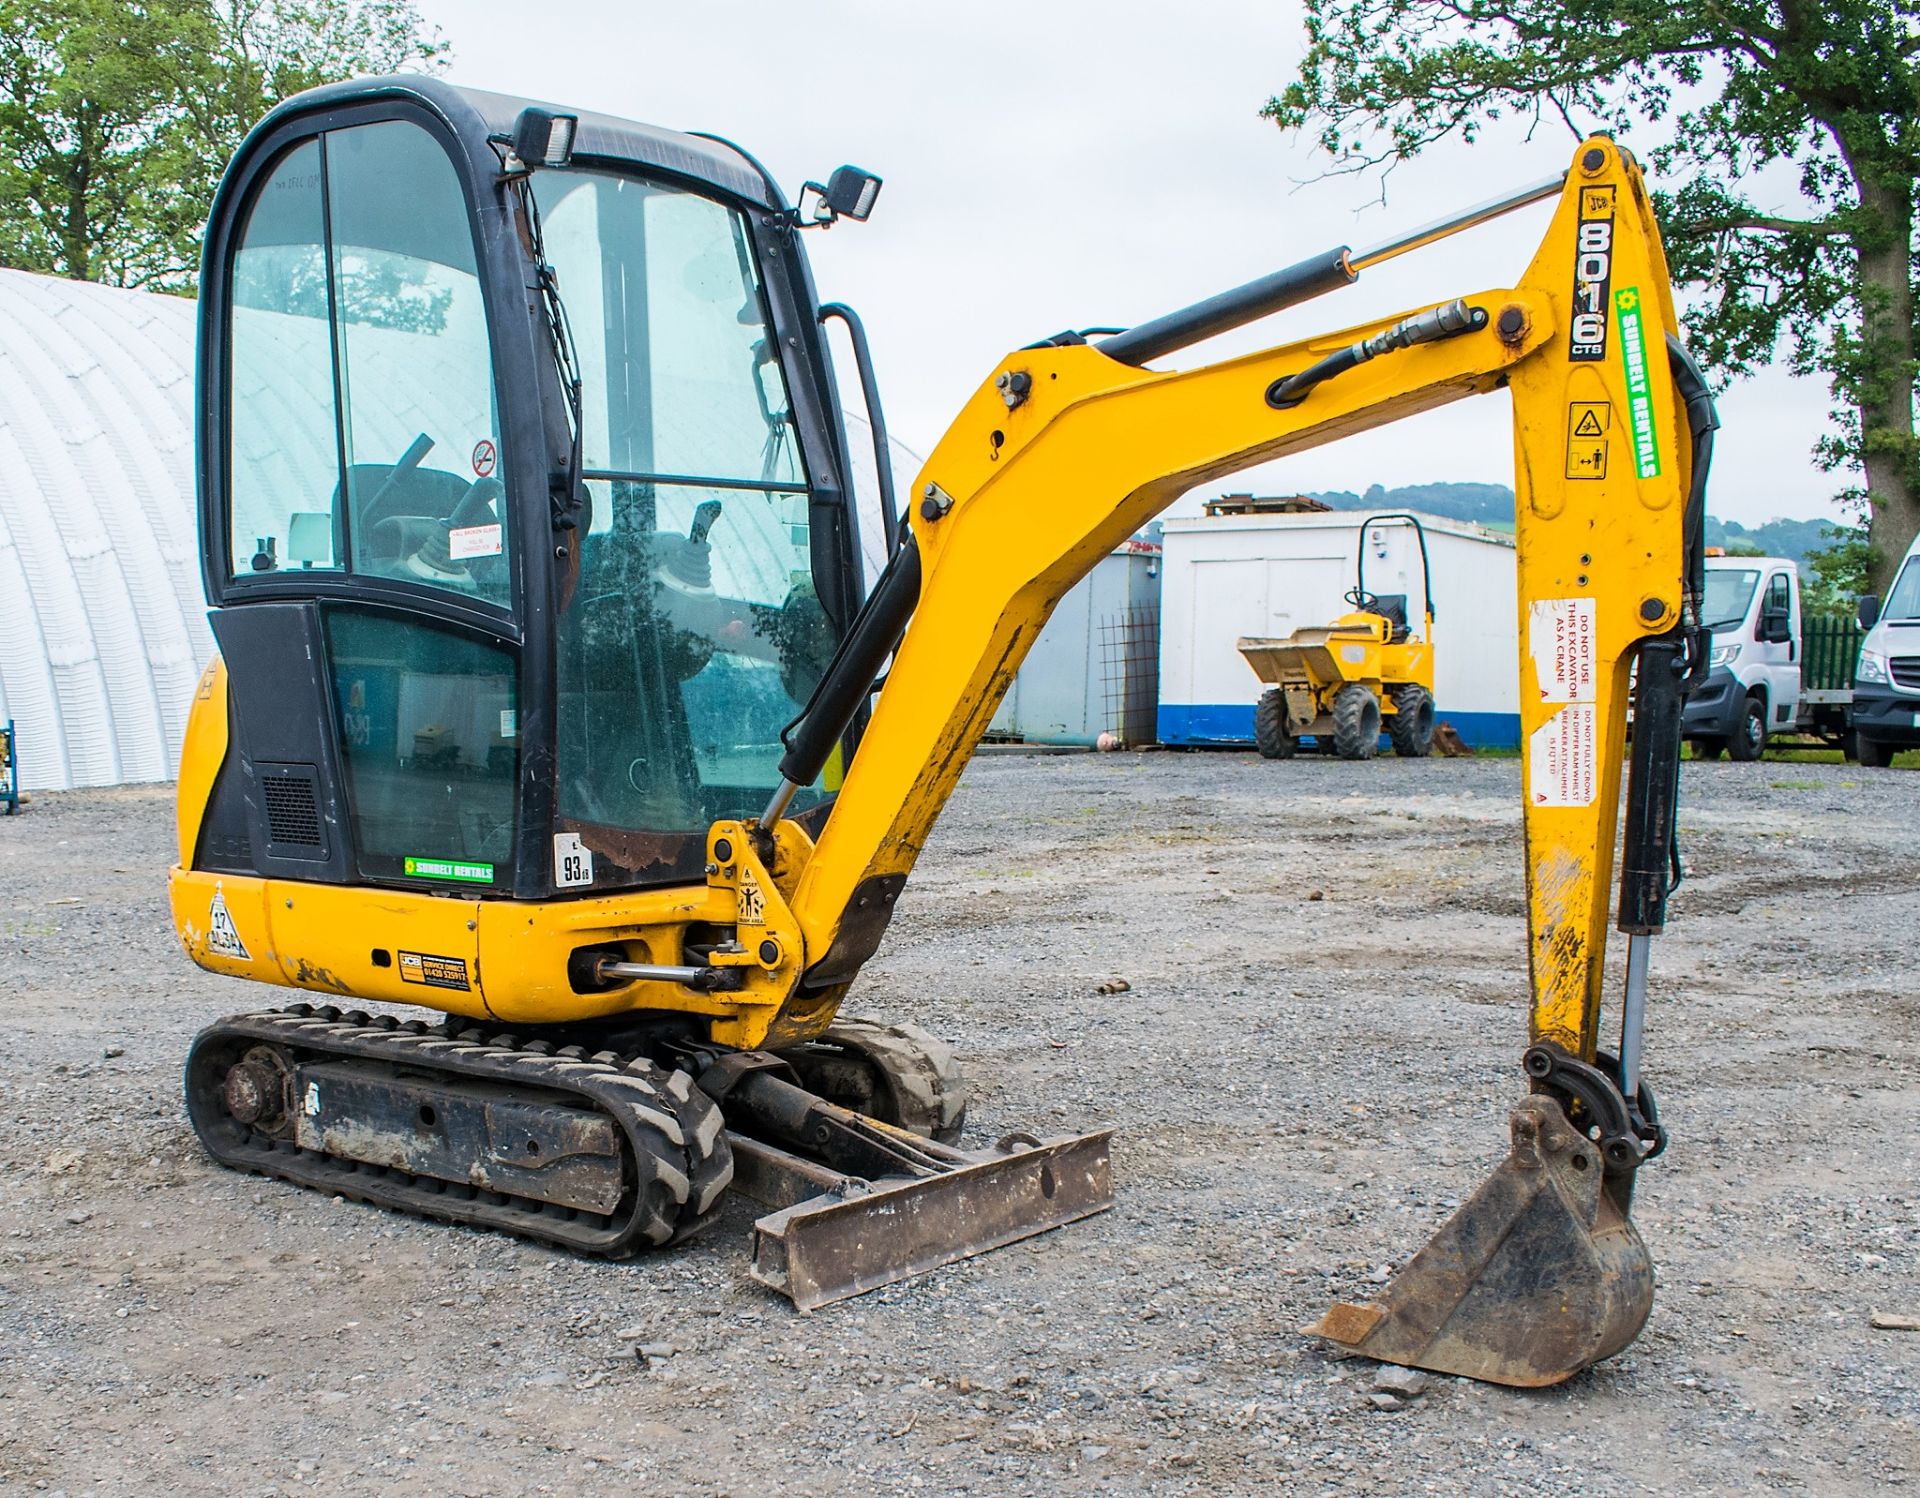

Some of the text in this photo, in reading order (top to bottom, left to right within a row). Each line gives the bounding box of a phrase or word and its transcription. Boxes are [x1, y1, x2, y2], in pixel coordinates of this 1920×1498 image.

[1572, 222, 1611, 344] 8016
[1571, 344, 1602, 355] CTS
[1622, 313, 1657, 479] SUNBELT RENTALS
[1556, 617, 1565, 684] AS A CRANE
[1568, 602, 1577, 699] THIS EXCAVATOR
[1580, 615, 1589, 685] DO NOT USE
[1584, 710, 1591, 723] DO
[1561, 710, 1569, 802] BREAKER ATTACHMENT
[1572, 710, 1580, 801] IN DIPPER RAM WHILST
[416, 862, 492, 879] SUNBELT RENTALS
[564, 855, 581, 882] 93
[423, 961, 444, 970] SERVICE
[445, 964, 465, 973] DIRECT
